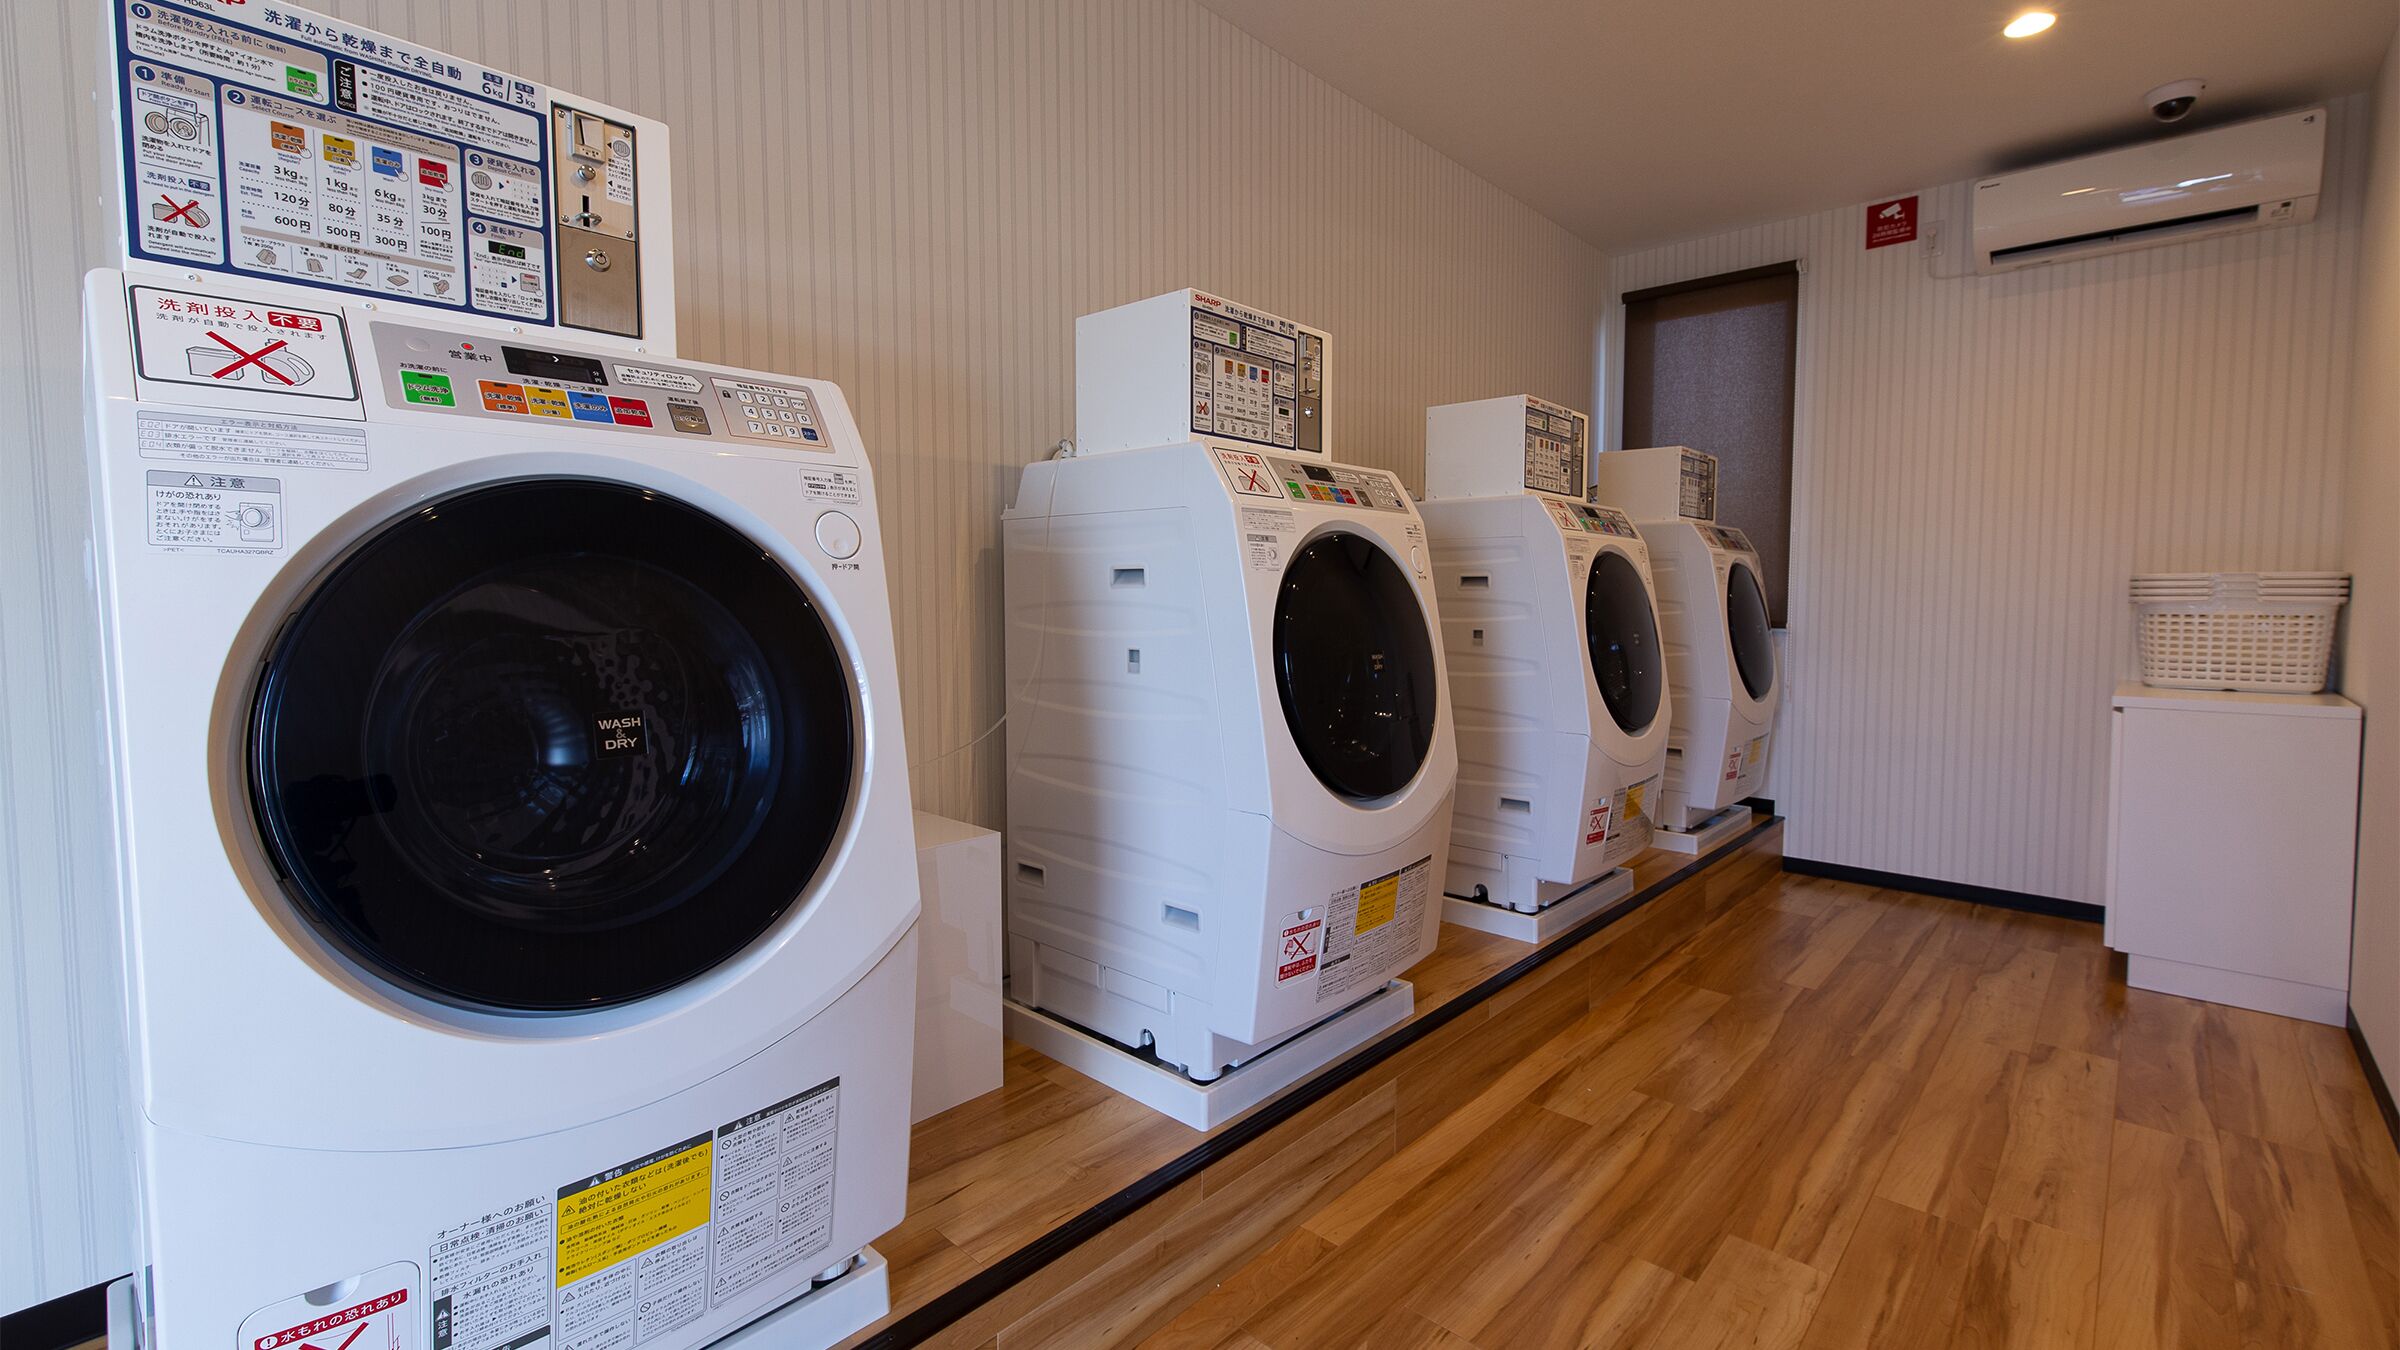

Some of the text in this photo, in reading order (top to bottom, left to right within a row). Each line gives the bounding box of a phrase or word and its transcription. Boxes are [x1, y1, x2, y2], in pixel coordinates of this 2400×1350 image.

[137, 6, 145, 15] 0
[158, 10, 263, 48] 洗濯物を入れる前に
[264, 8, 462, 80] 洗濯から乾燥まで全自動
[341, 67, 352, 100] ご注意
[193, 89, 210, 98] Start
[250, 95, 337, 124] 運転コースを選ぶ
[487, 157, 536, 176] 硬貨を入れる
[147, 171, 186, 186] 洗剤投入
[275, 215, 311, 231] 600円
[326, 225, 360, 240] 500円
[421, 225, 451, 239] 100円
[375, 235, 407, 249] 300円
[498, 244, 524, 258] End
[1195, 294, 1221, 307] SHARP
[157, 297, 320, 330] 洗剤投入 不要
[156, 312, 327, 341] 洗剤が自動で投入されます
[448, 349, 492, 362] 営業中
[210, 476, 245, 488] 注意
[155, 490, 221, 501] けがの恐れあり
[156, 501, 221, 510] ドアを開け閉めする
[598, 717, 641, 729] WASH
[616, 728, 626, 738] &
[605, 737, 637, 750] DRY
[437, 1196, 545, 1240] オーナー様へのお願い
[440, 1209, 544, 1252] 日常点検・清掃のお願い
[441, 1253, 542, 1296] 排水フィルターのお手入れ
[281, 1293, 402, 1343] 水もれの恐れあり
